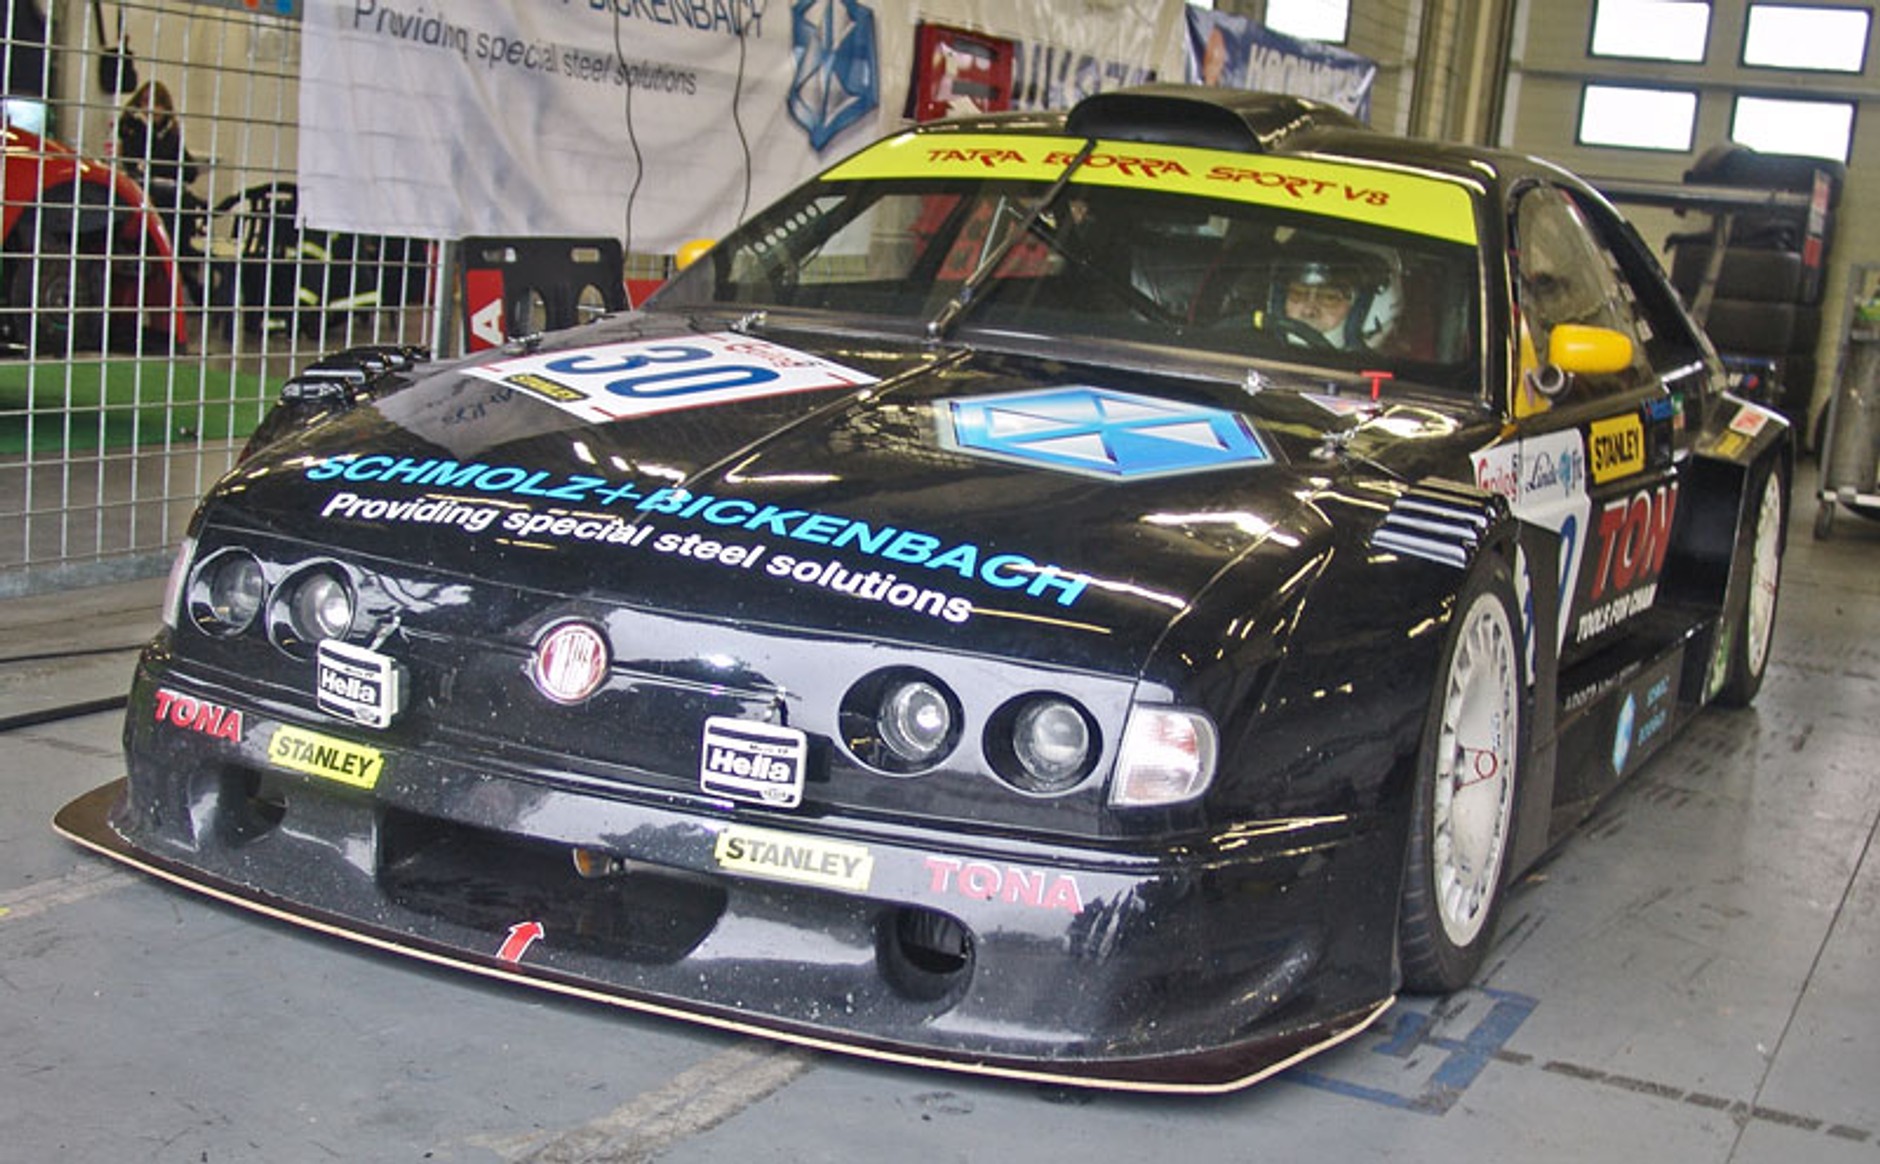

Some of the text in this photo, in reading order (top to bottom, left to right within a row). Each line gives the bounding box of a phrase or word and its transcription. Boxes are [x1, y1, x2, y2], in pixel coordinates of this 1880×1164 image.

[354, 0, 697, 95] Providing special steel solutions
[927, 149, 1026, 168] TATRA
[1206, 166, 1337, 199] SPORT
[1344, 184, 1390, 206] V8
[546, 345, 779, 399] 30
[1594, 426, 1640, 472] STANLEY
[321, 492, 973, 623] Providing special steel solutions
[322, 667, 376, 705] Hella
[154, 688, 242, 743] TONA
[276, 735, 375, 780] STANLEY
[709, 747, 791, 783] Hella
[725, 836, 863, 879] STANLEY
[922, 856, 1084, 913] TONA
